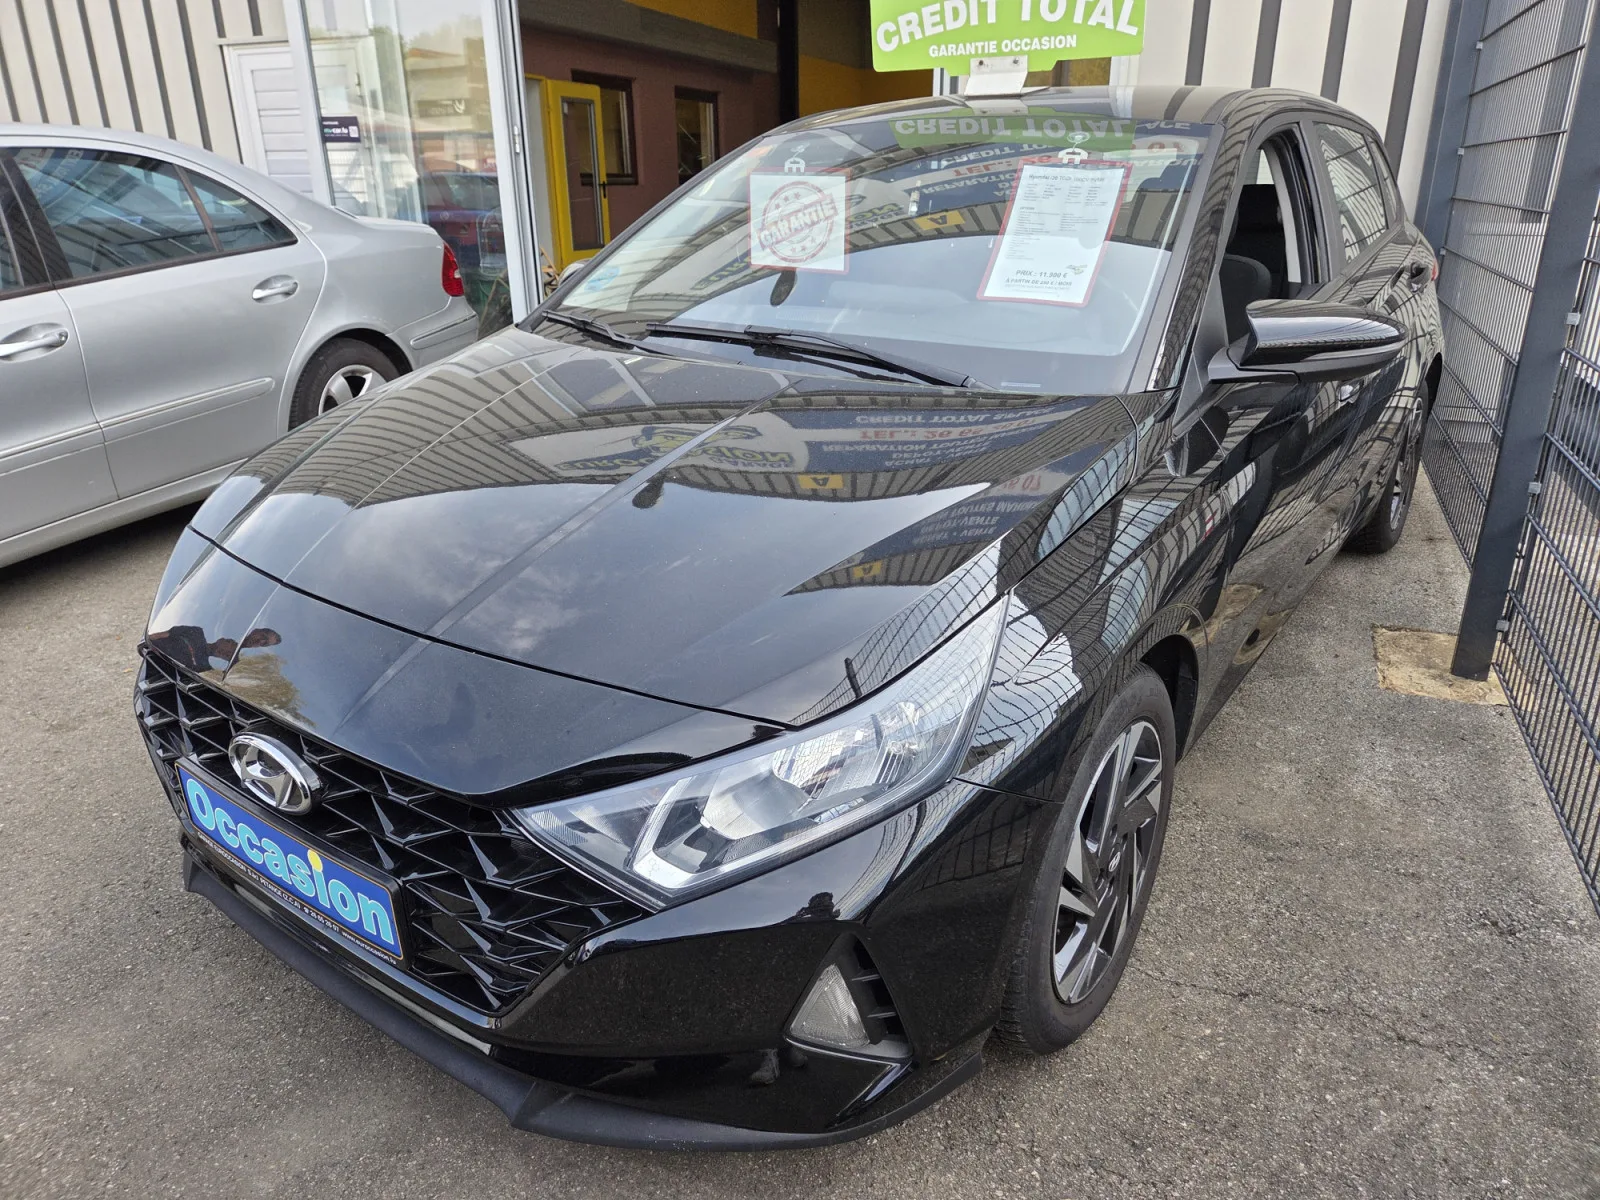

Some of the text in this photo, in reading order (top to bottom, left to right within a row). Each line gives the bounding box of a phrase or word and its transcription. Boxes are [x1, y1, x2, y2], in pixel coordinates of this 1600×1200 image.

[876, 0, 1139, 52] CREDIT TOTAL
[929, 35, 1077, 57] GARANTIE OCCASION
[186, 777, 395, 946] Occasion
